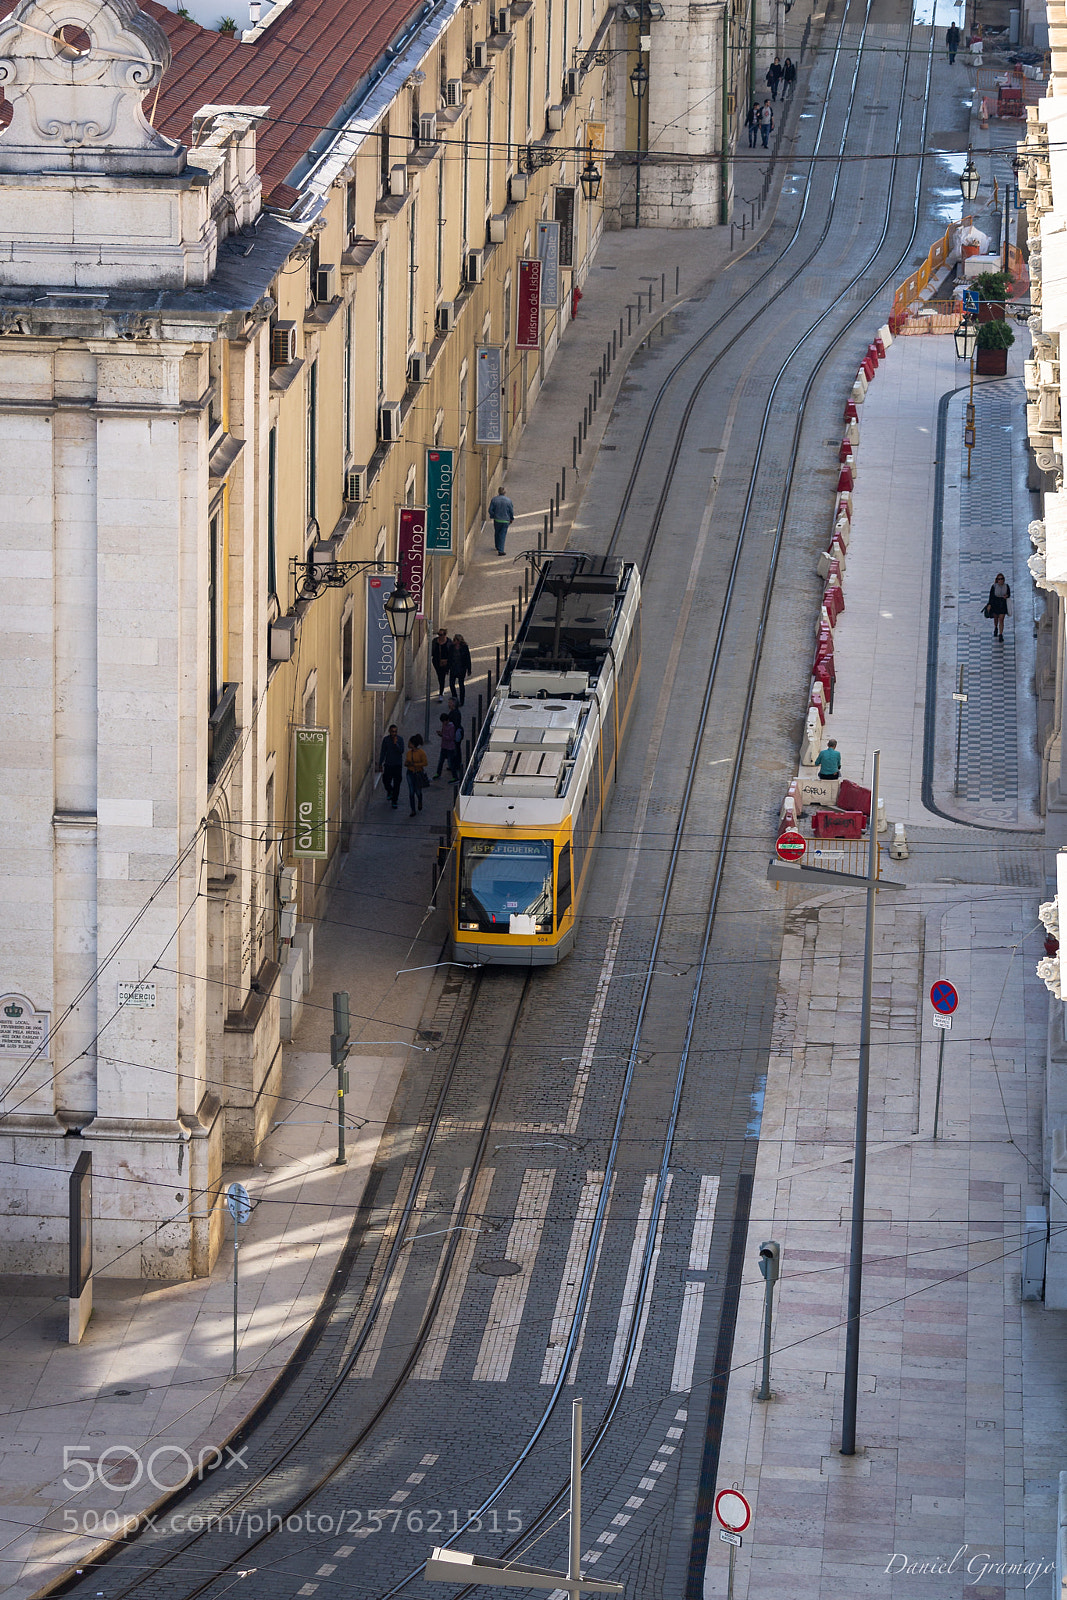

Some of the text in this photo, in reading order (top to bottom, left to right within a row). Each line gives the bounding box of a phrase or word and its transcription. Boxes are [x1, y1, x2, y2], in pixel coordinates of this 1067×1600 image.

[527, 262, 539, 344] Turismo de Lisboa
[545, 236, 557, 303] Pátio da Galé
[486, 363, 499, 439] Pátio da Galé
[436, 464, 452, 548] Lisbon Shop
[408, 524, 424, 611] isbon Shop
[377, 634, 393, 683] Lisbon
[299, 801, 313, 849] aura
[124, 983, 150, 991] PRAÇA
